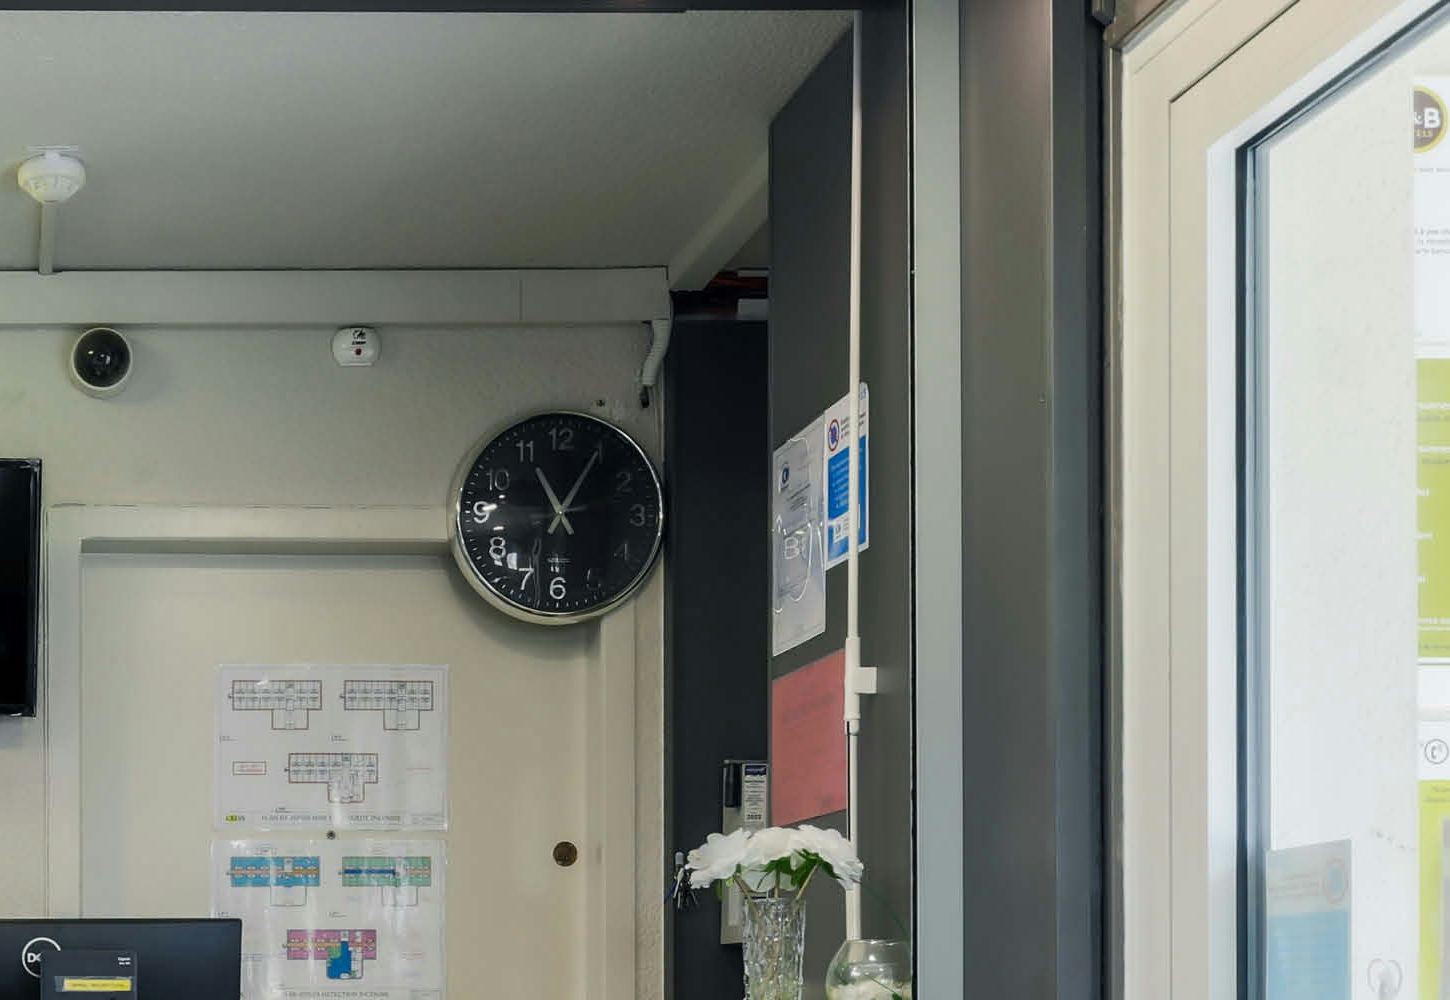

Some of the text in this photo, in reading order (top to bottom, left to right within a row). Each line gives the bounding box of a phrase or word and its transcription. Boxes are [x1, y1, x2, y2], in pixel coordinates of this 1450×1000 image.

[548, 427, 574, 451] 12
[516, 440, 535, 463] 11
[487, 469, 511, 492] 10
[615, 471, 632, 493] 2
[472, 500, 492, 524] 9
[629, 503, 645, 527] 3
[488, 536, 507, 561] 8
[613, 541, 632, 562] 4
[516, 567, 535, 591] 7
[549, 576, 567, 600] 6
